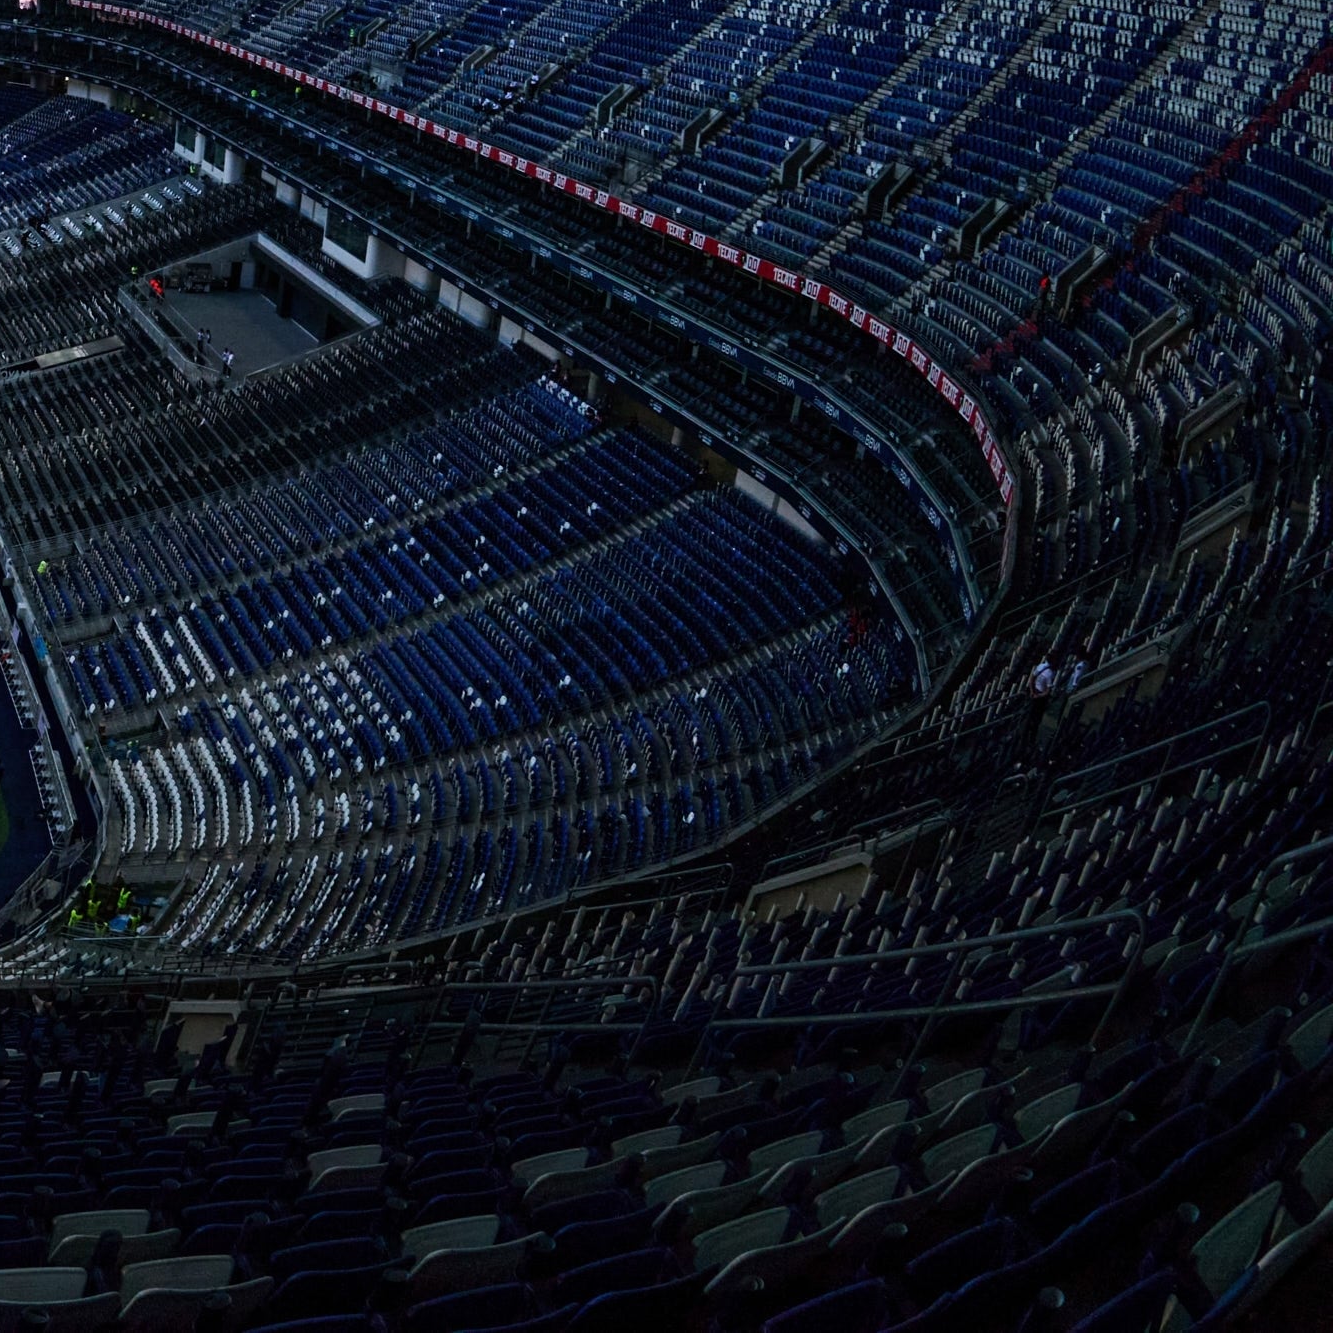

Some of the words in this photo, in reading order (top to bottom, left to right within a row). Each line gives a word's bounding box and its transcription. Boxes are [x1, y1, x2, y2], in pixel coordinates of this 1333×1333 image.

[619, 201, 638, 219] TECATE
[666, 221, 686, 241] TECATE
[717, 243, 739, 264] TECATE
[773, 266, 797, 289] TECATE
[623, 289, 637, 304] BBVA
[828, 291, 848, 314] TECATE
[670, 315, 685, 330] BBVA
[868, 318, 891, 343] TECATE
[721, 341, 737, 358] BBVA
[776, 371, 795, 390] BBVA
[825, 402, 840, 421] BBVA
[865, 433, 881, 454] BBVA
